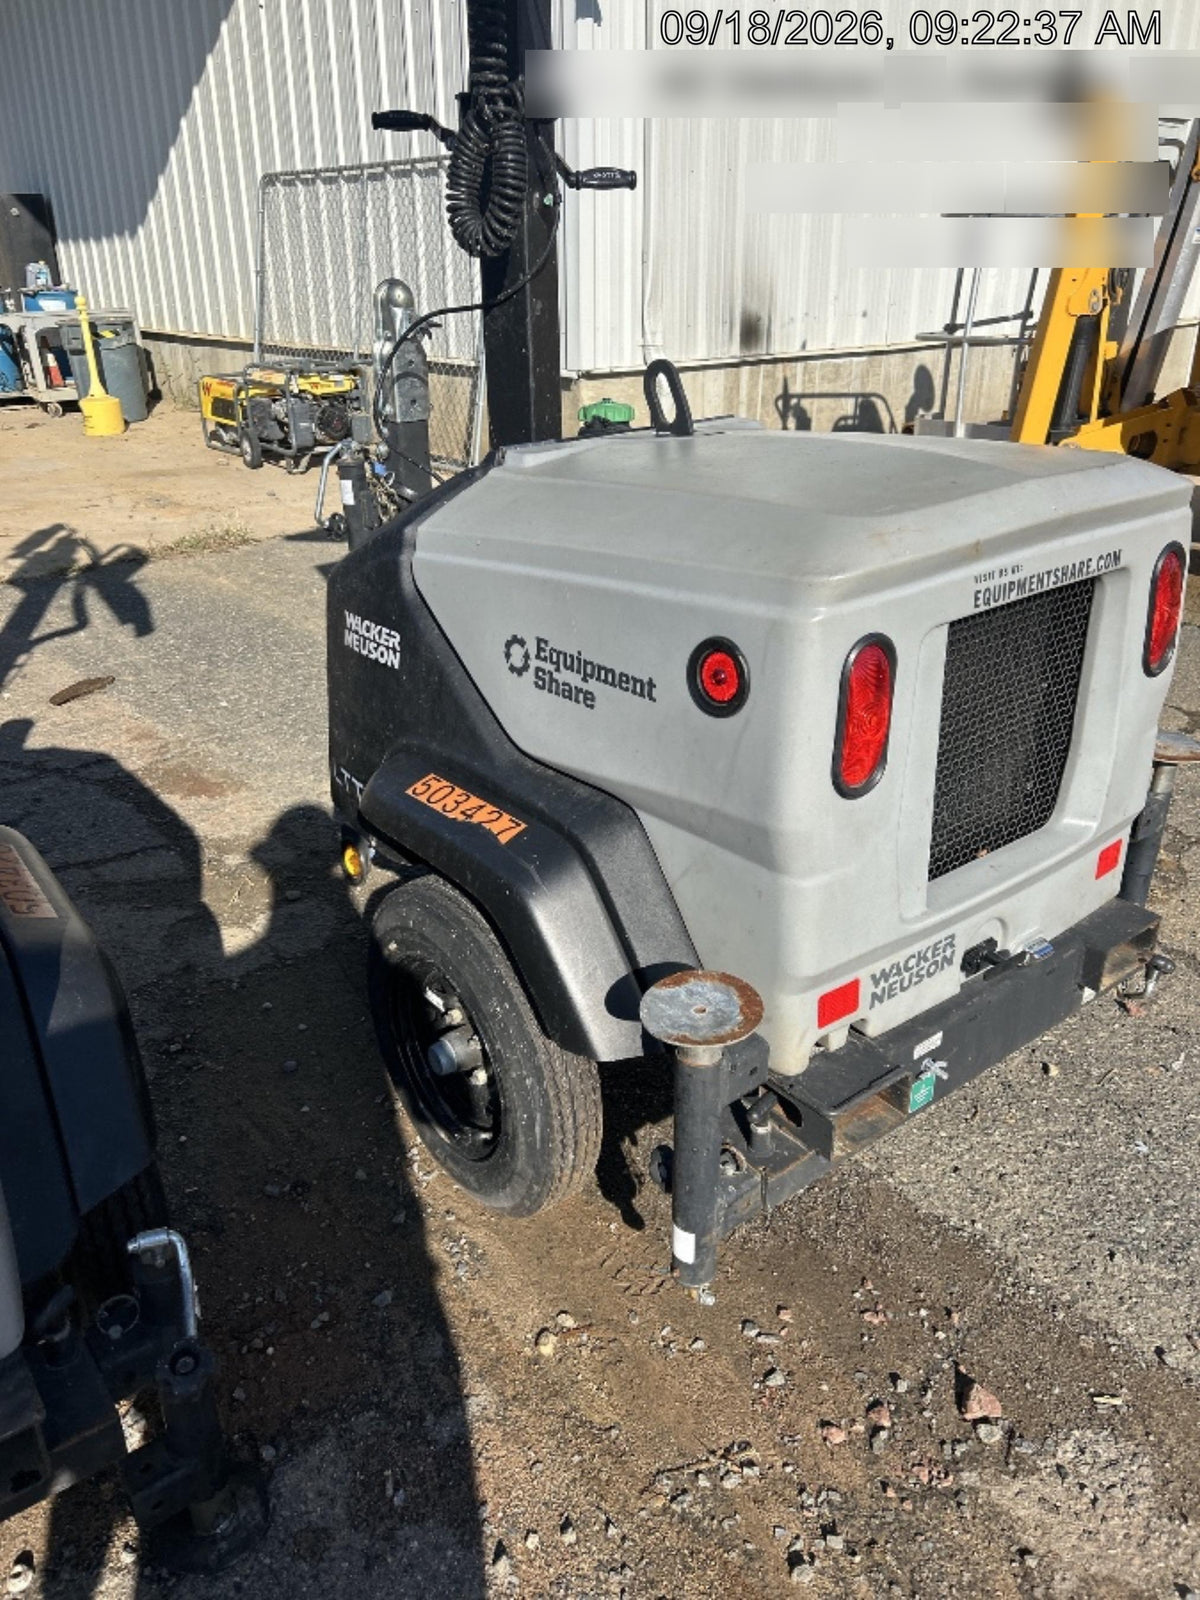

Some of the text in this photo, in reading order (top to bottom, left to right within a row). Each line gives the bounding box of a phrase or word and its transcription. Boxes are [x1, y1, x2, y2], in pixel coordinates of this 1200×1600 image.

[973, 549, 1122, 609] EQUIPMENTSHARE.COM
[344, 609, 400, 652] WACKER
[344, 629, 400, 670] NEUSON
[533, 666, 597, 710] Share
[535, 636, 657, 703] Equipment
[411, 776, 522, 837] 503427
[869, 949, 955, 1011] NEUSON
[870, 933, 956, 989] WACKER
